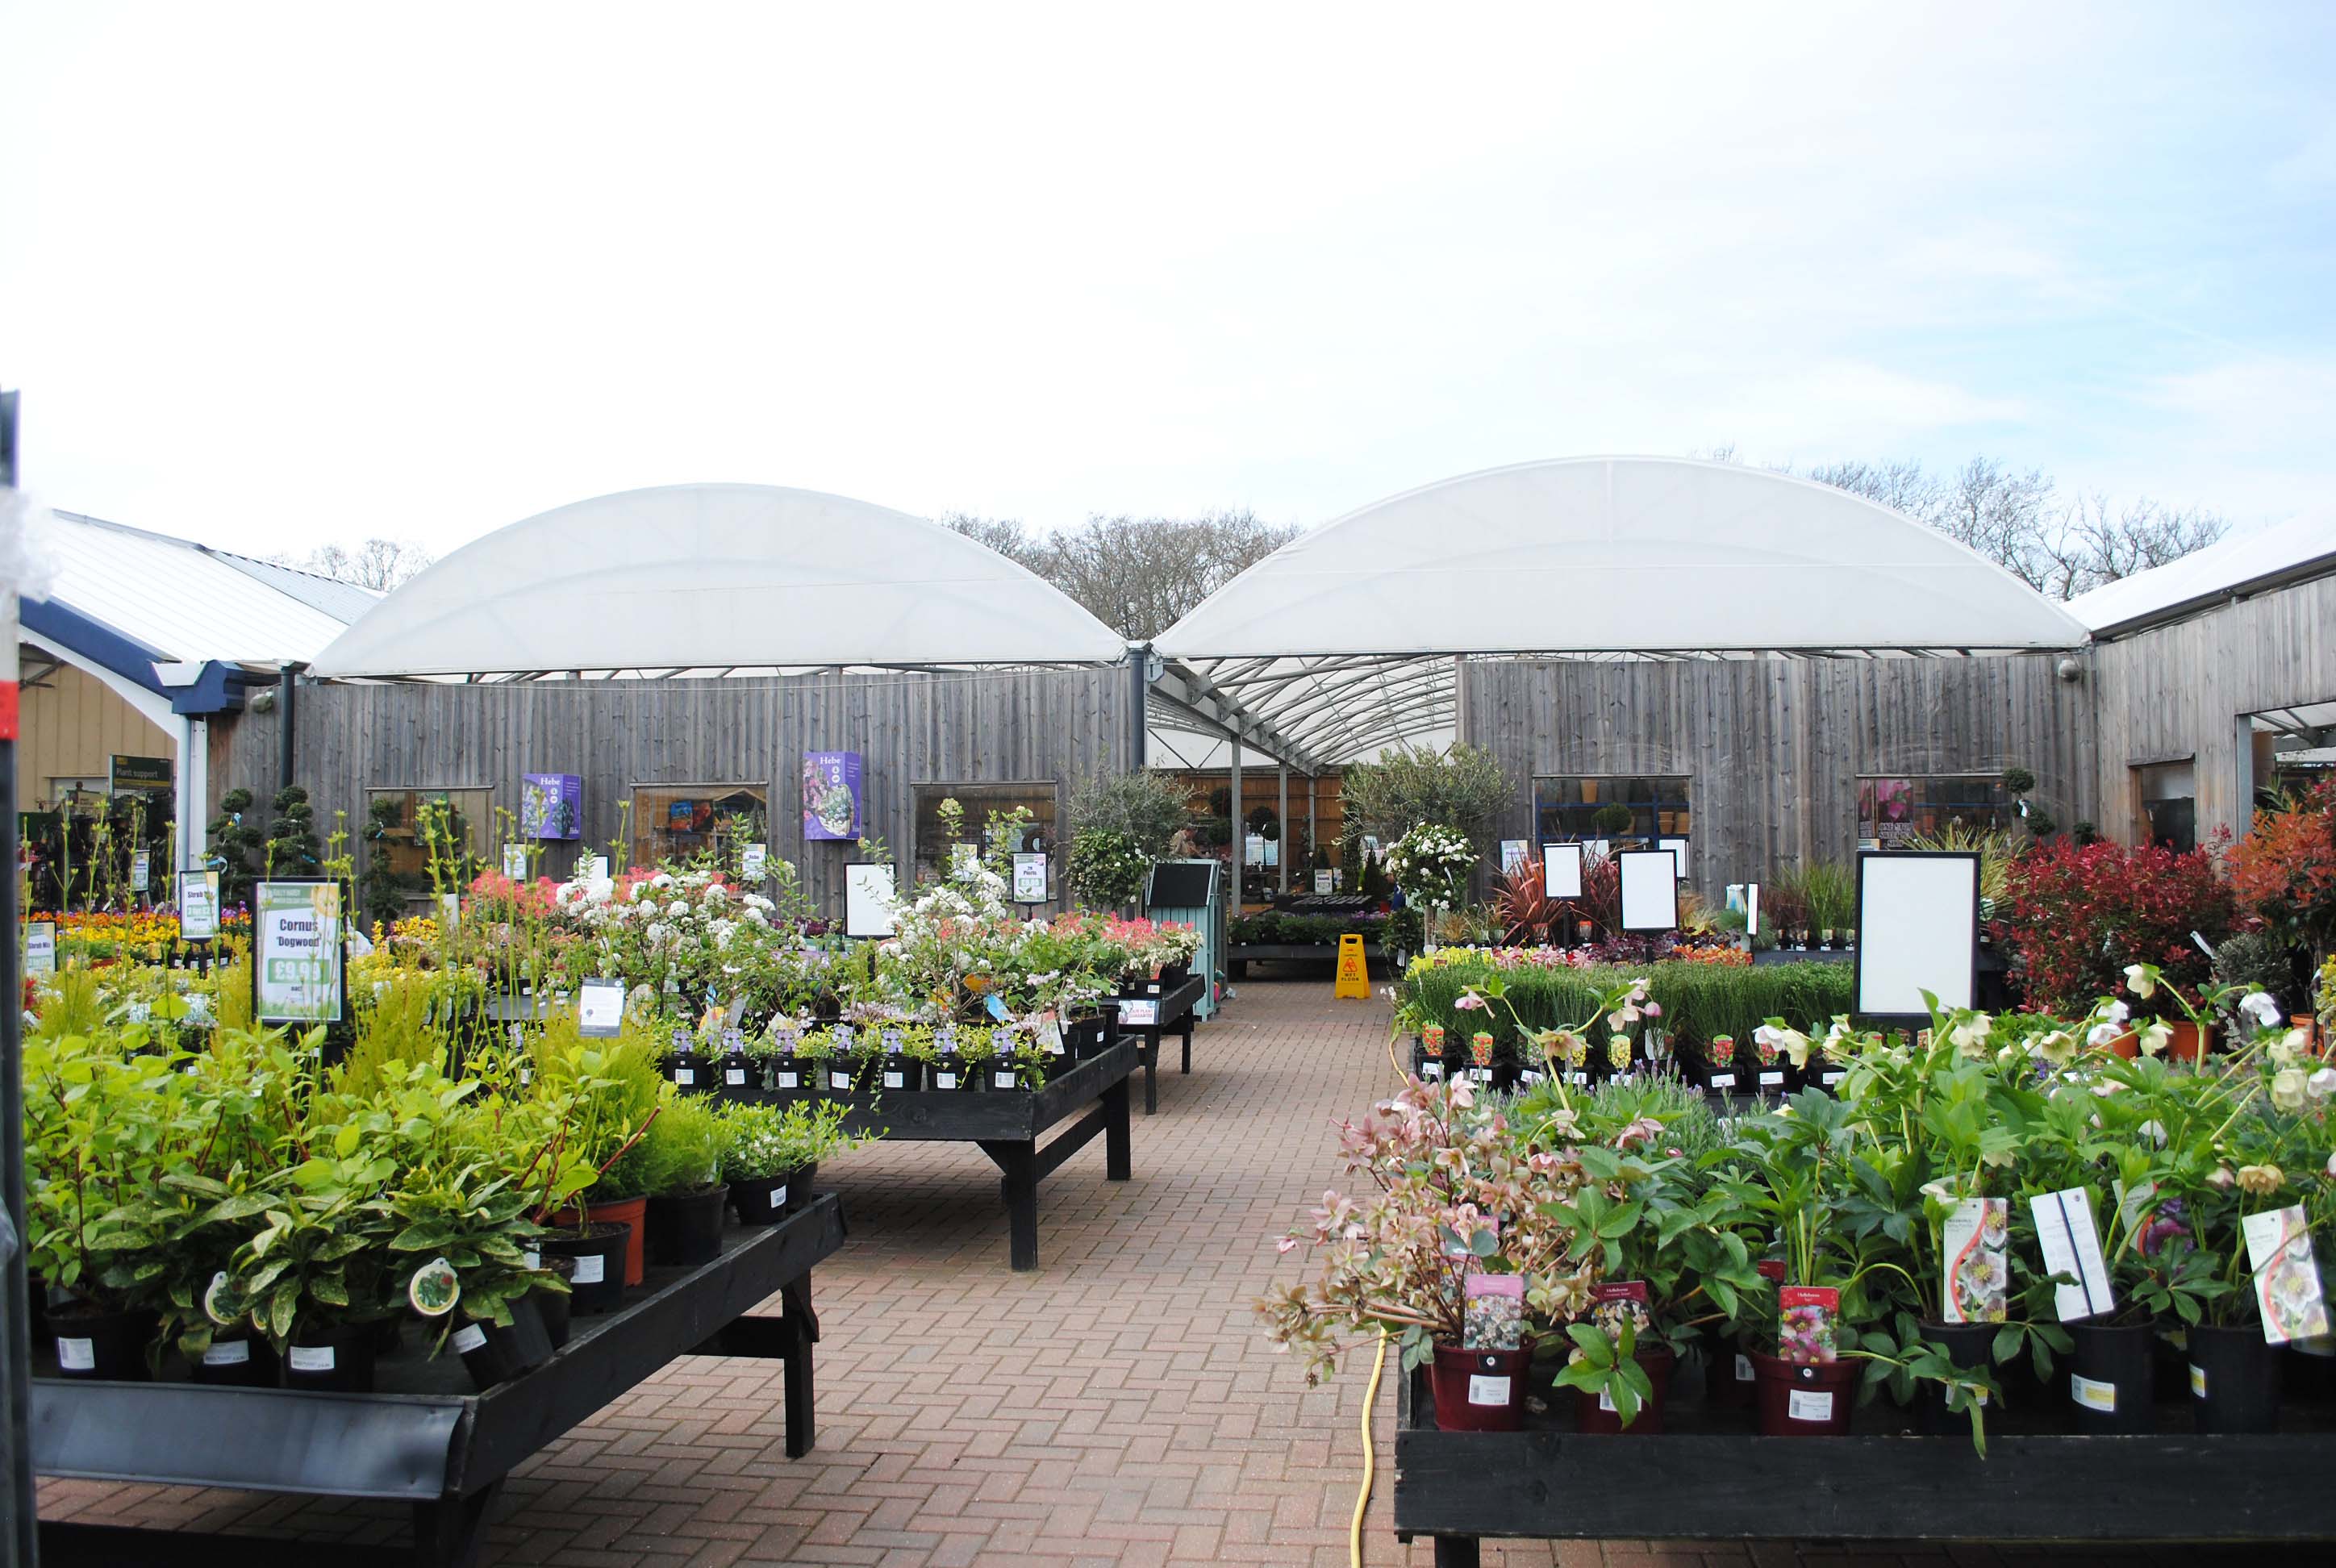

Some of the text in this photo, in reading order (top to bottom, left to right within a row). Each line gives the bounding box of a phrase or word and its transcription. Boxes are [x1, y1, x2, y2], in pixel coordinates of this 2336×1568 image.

[820, 757, 841, 765] Hebe
[116, 767, 158, 780] Plant support
[540, 778, 561, 786] Hebe
[280, 919, 318, 932] Cornus
